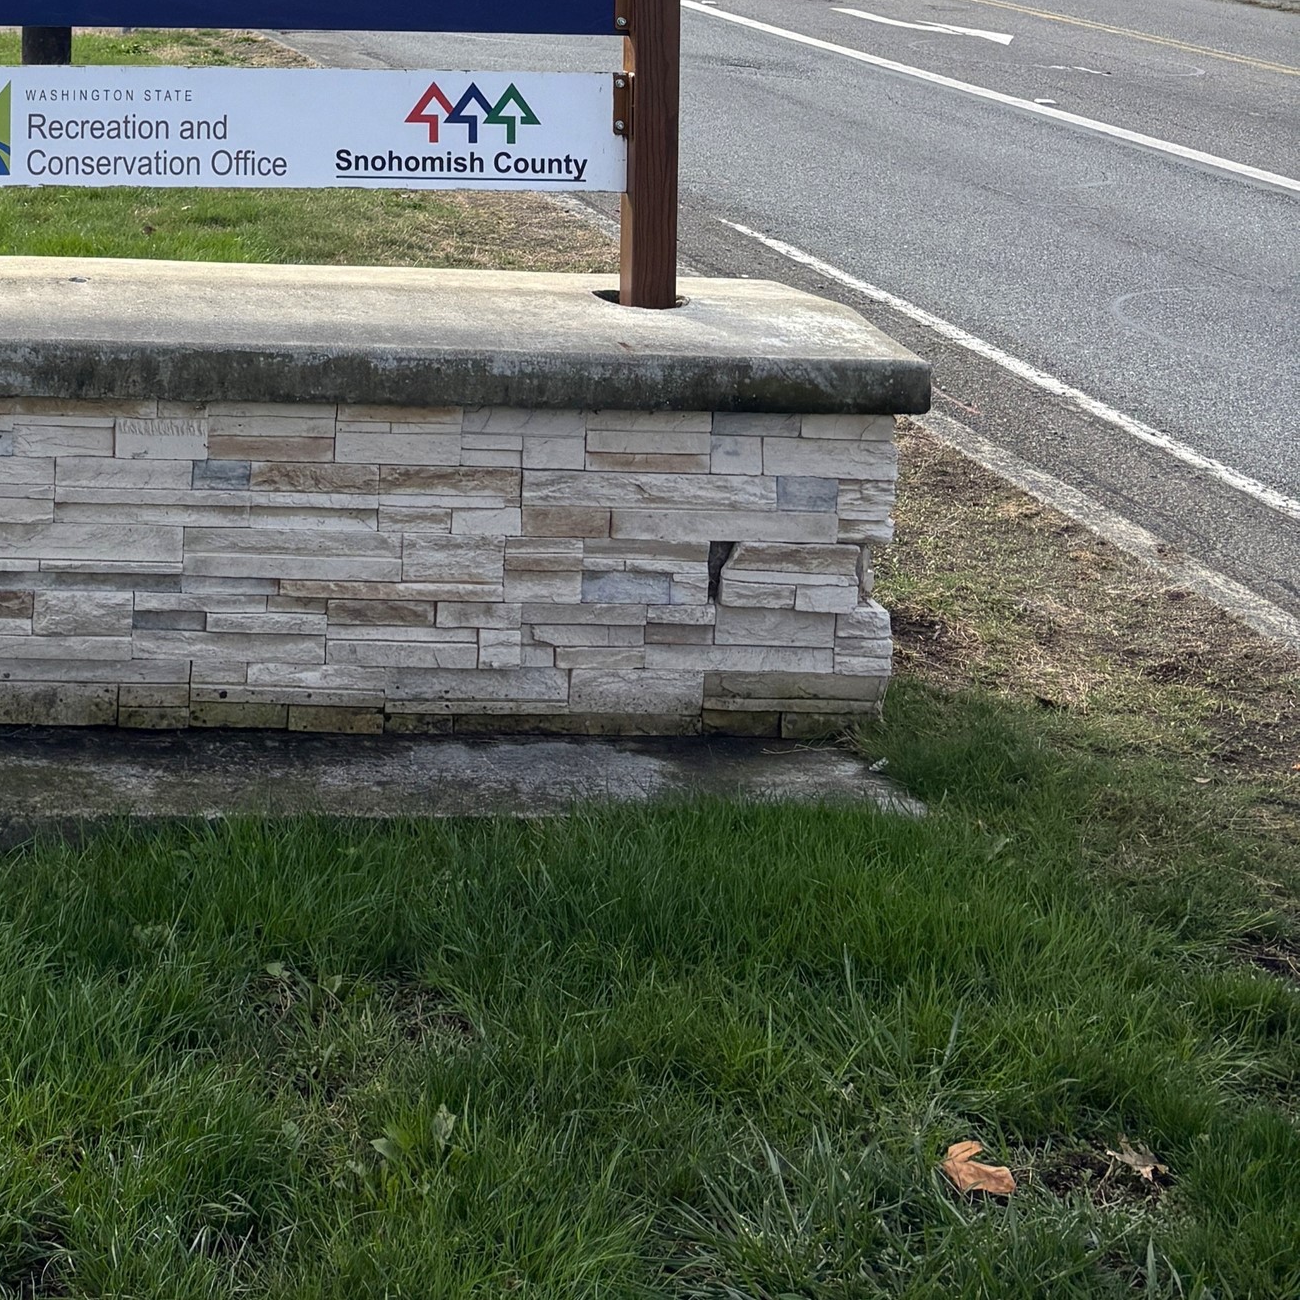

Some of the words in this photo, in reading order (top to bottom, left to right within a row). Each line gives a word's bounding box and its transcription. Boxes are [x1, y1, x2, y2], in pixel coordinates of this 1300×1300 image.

[26, 89, 133, 101] WASHINGTON
[144, 90, 192, 101] STATE
[28, 114, 169, 139] Recreation
[180, 115, 227, 140] and
[27, 150, 200, 175] Conservation
[212, 150, 287, 176] Office
[336, 149, 484, 172] Snohomish
[493, 151, 588, 180] County
